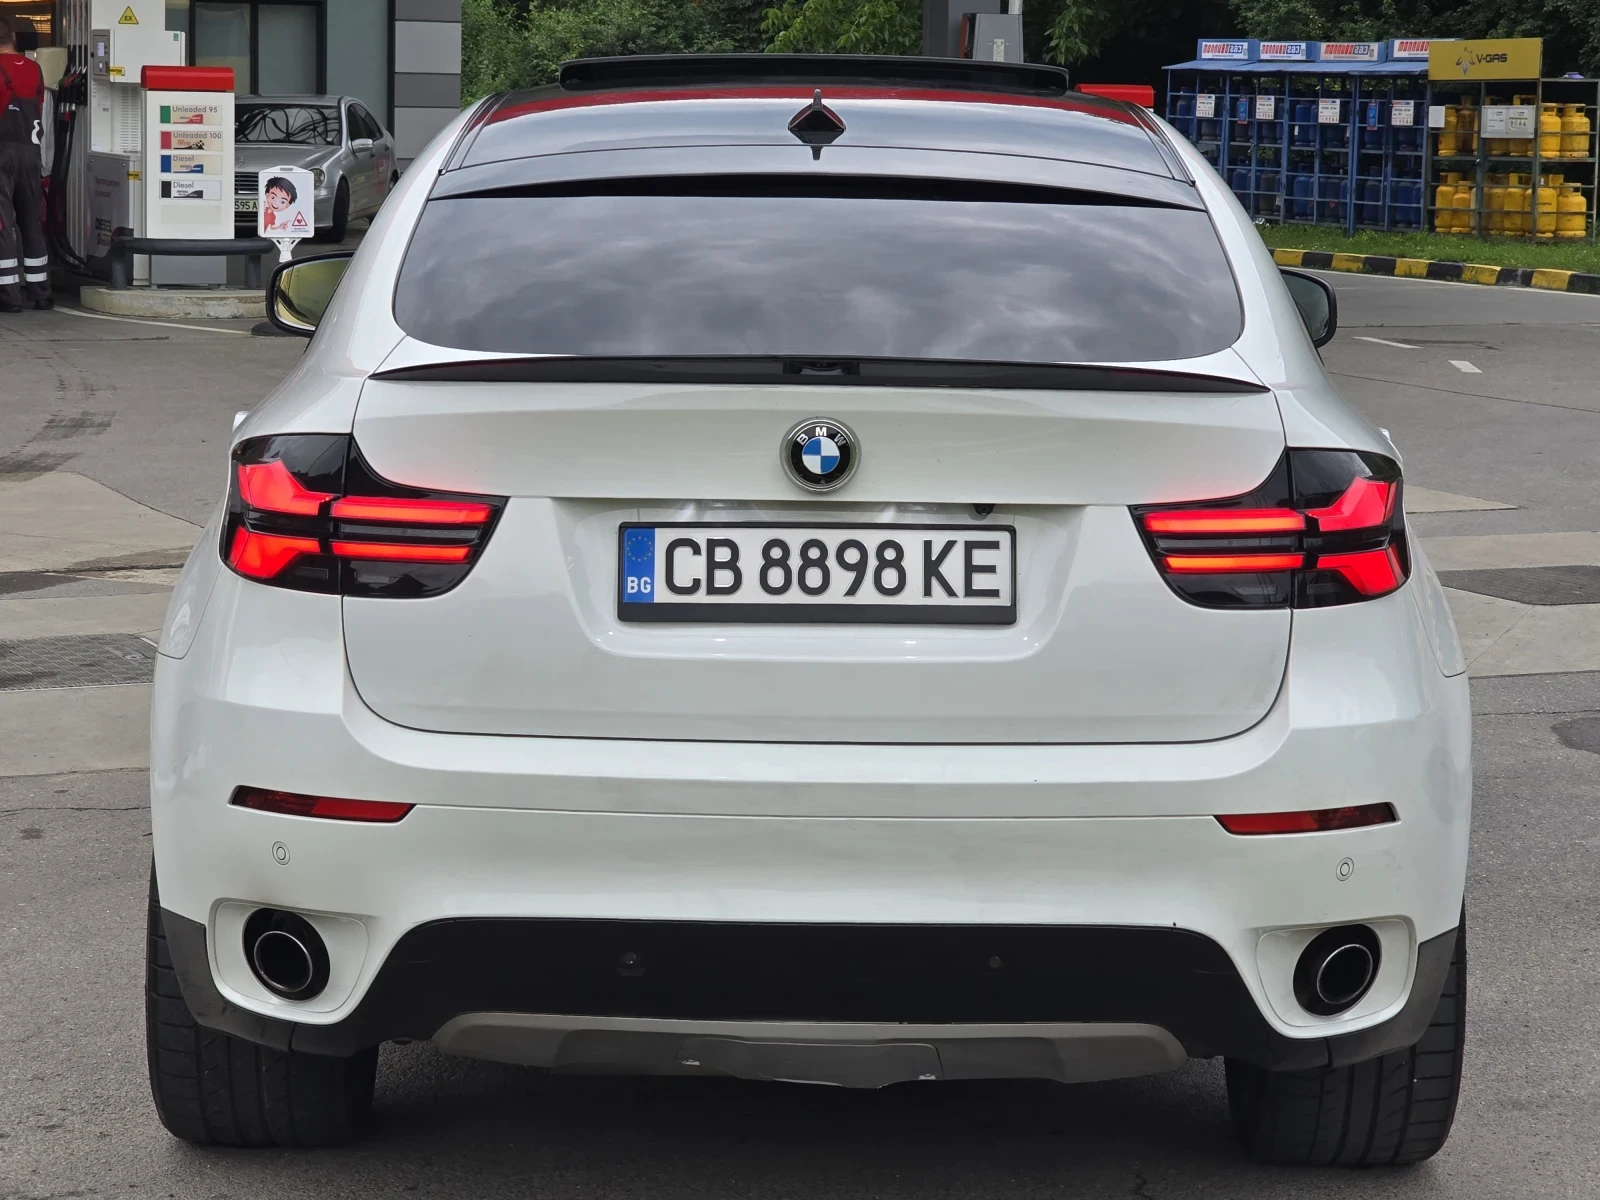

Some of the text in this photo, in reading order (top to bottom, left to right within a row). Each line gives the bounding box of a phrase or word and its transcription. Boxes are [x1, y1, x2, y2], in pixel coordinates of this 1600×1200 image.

[1475, 53, 1508, 64] V-GAS
[172, 105, 207, 113] Unleaded
[173, 131, 208, 139] Unleaded
[172, 181, 195, 189] Diesel
[796, 426, 847, 447] BMW
[664, 537, 1001, 598] CB 8898 KE
[626, 576, 652, 594] BG
